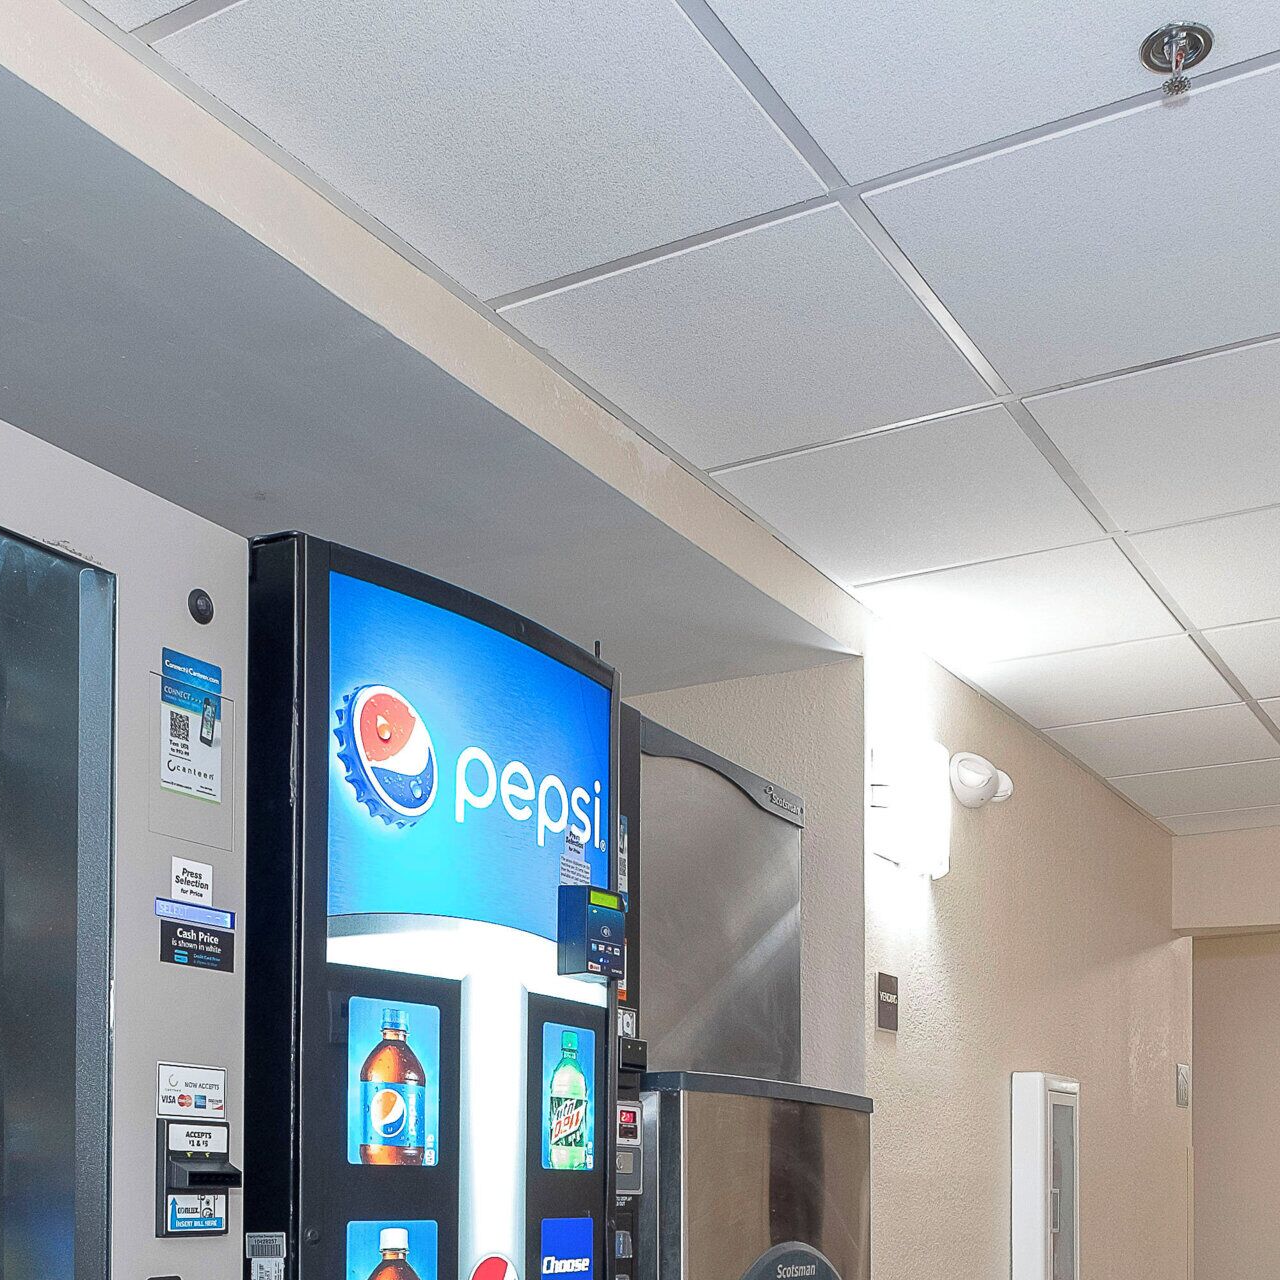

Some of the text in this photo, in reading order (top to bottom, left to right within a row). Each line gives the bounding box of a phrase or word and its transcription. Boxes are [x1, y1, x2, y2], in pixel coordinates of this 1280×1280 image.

[455, 746, 603, 848] pepsi
[182, 868, 202, 879] Press
[175, 876, 208, 890] Selection
[190, 890, 203, 898] Price
[176, 928, 218, 944] Cash Price
[178, 940, 197, 949] shown
[206, 944, 222, 954] white
[199, 1082, 220, 1090] ACCEPTS
[161, 1095, 176, 1104] VISA
[186, 1131, 211, 1139] ACCEPTS
[542, 1256, 590, 1275] Choose
[776, 1263, 816, 1278] Scotsman
